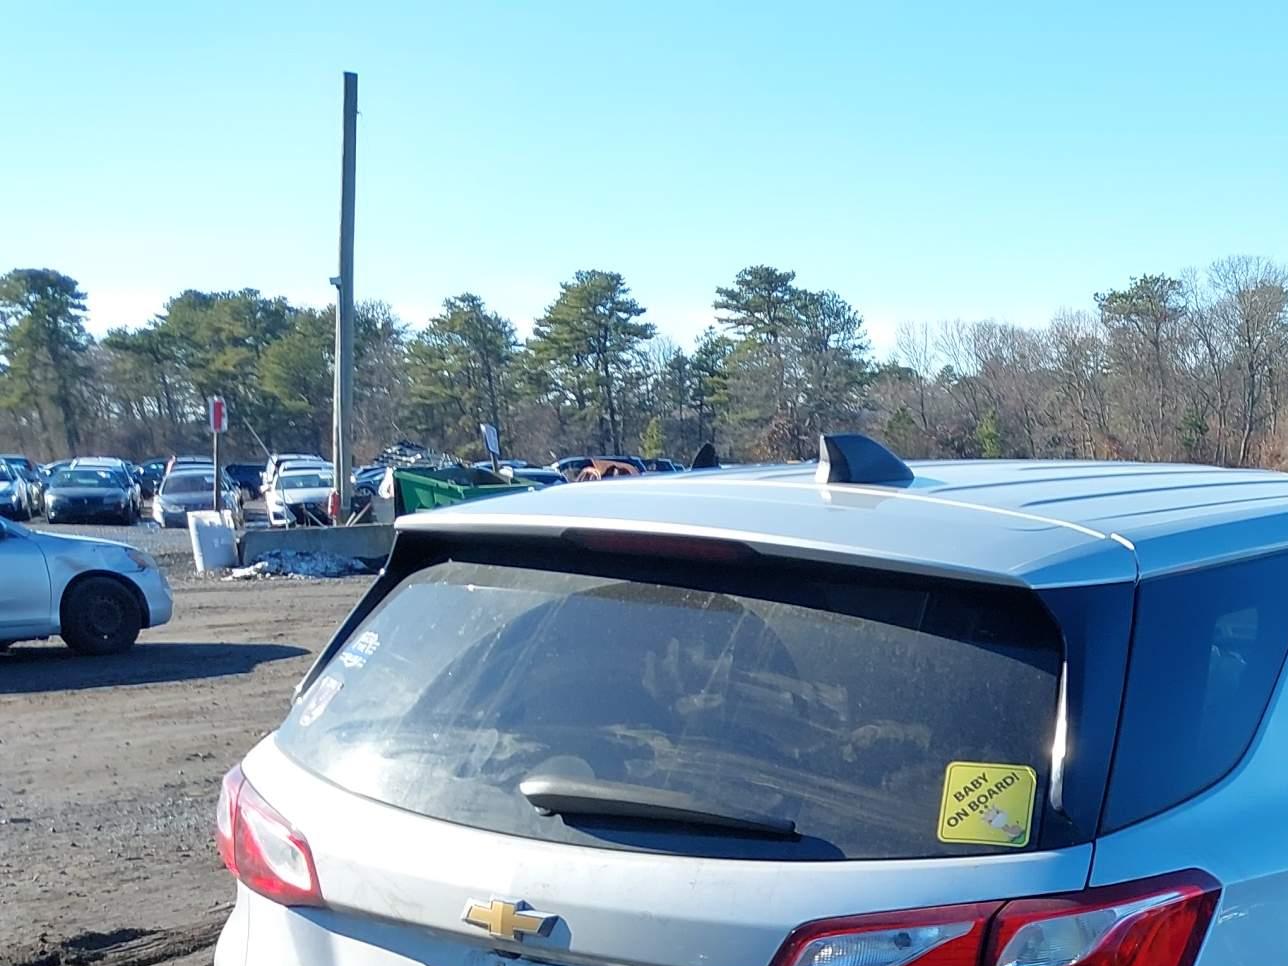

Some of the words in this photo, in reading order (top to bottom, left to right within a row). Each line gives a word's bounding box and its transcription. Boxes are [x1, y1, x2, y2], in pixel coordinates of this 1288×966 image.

[947, 808, 969, 828] ON
[968, 771, 1020, 812] BOARD!
[953, 772, 990, 802] BABY
